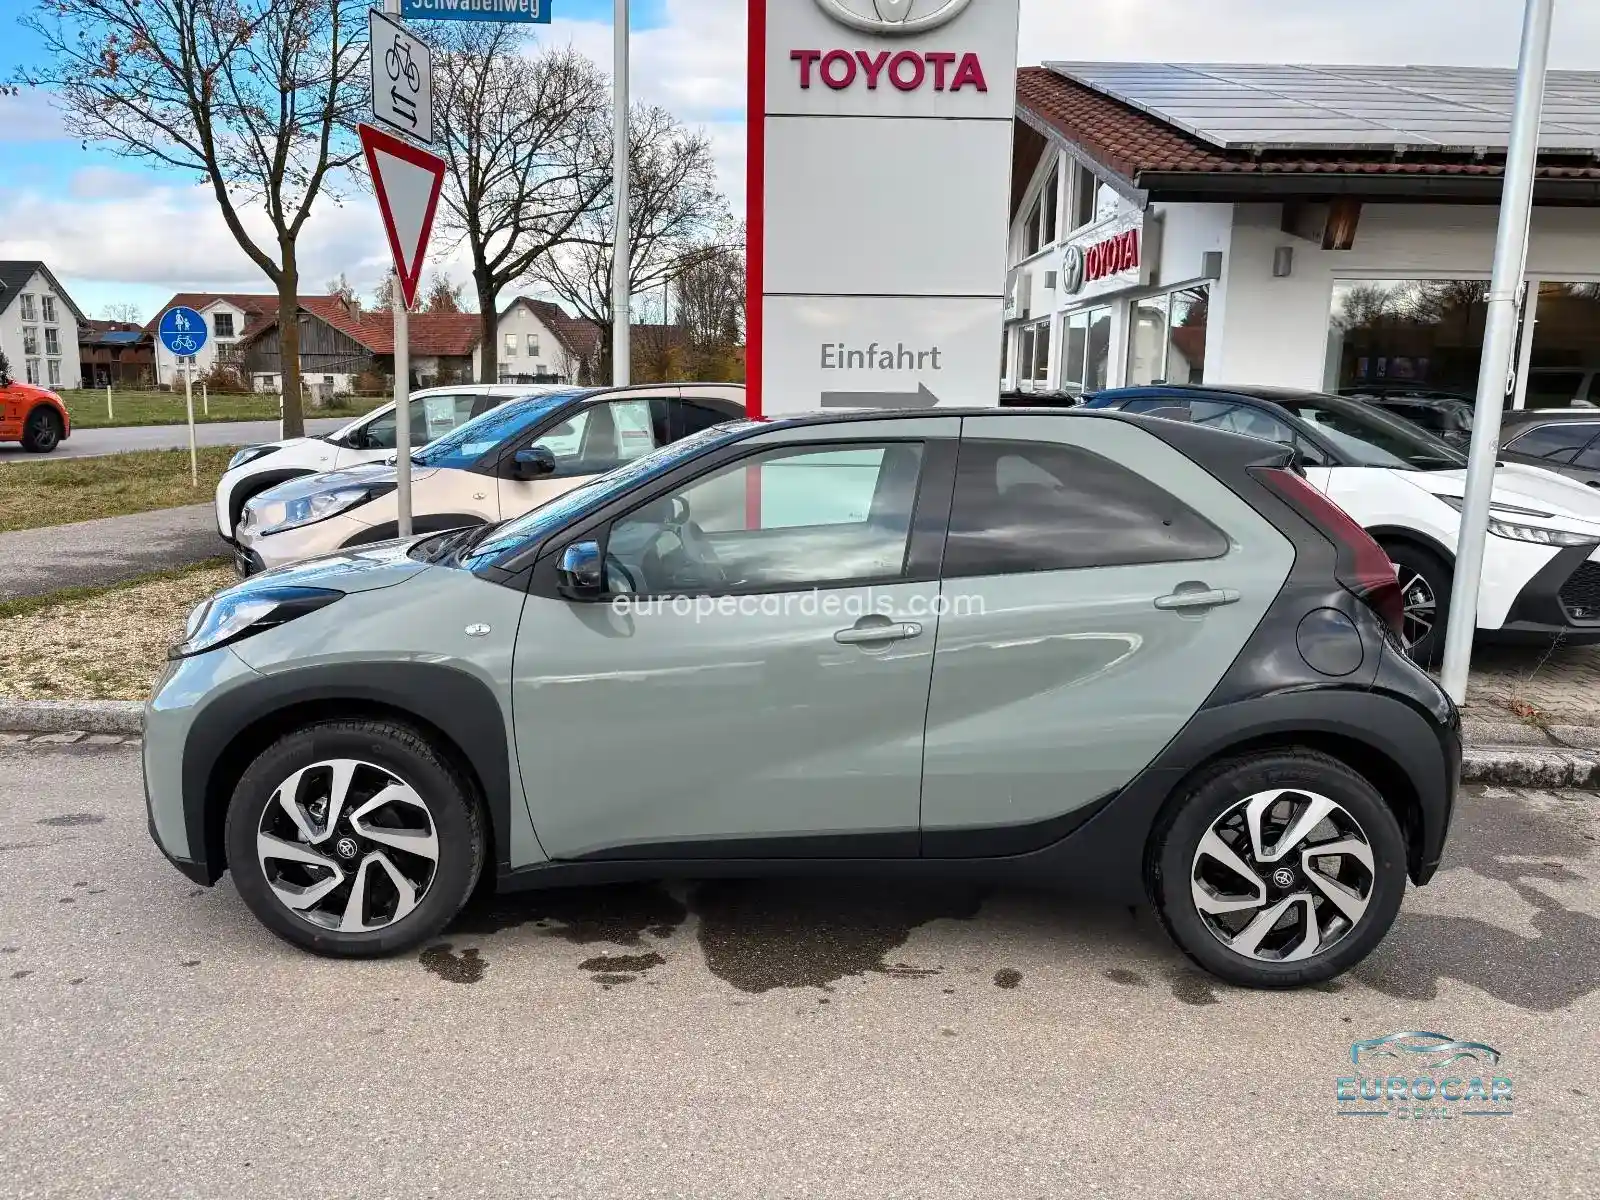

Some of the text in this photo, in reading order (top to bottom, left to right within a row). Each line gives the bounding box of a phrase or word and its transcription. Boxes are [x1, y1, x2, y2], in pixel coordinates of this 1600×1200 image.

[790, 48, 987, 92] TOYOTA
[1084, 229, 1138, 281] TOYOTA
[821, 342, 941, 370] Einfahrt
